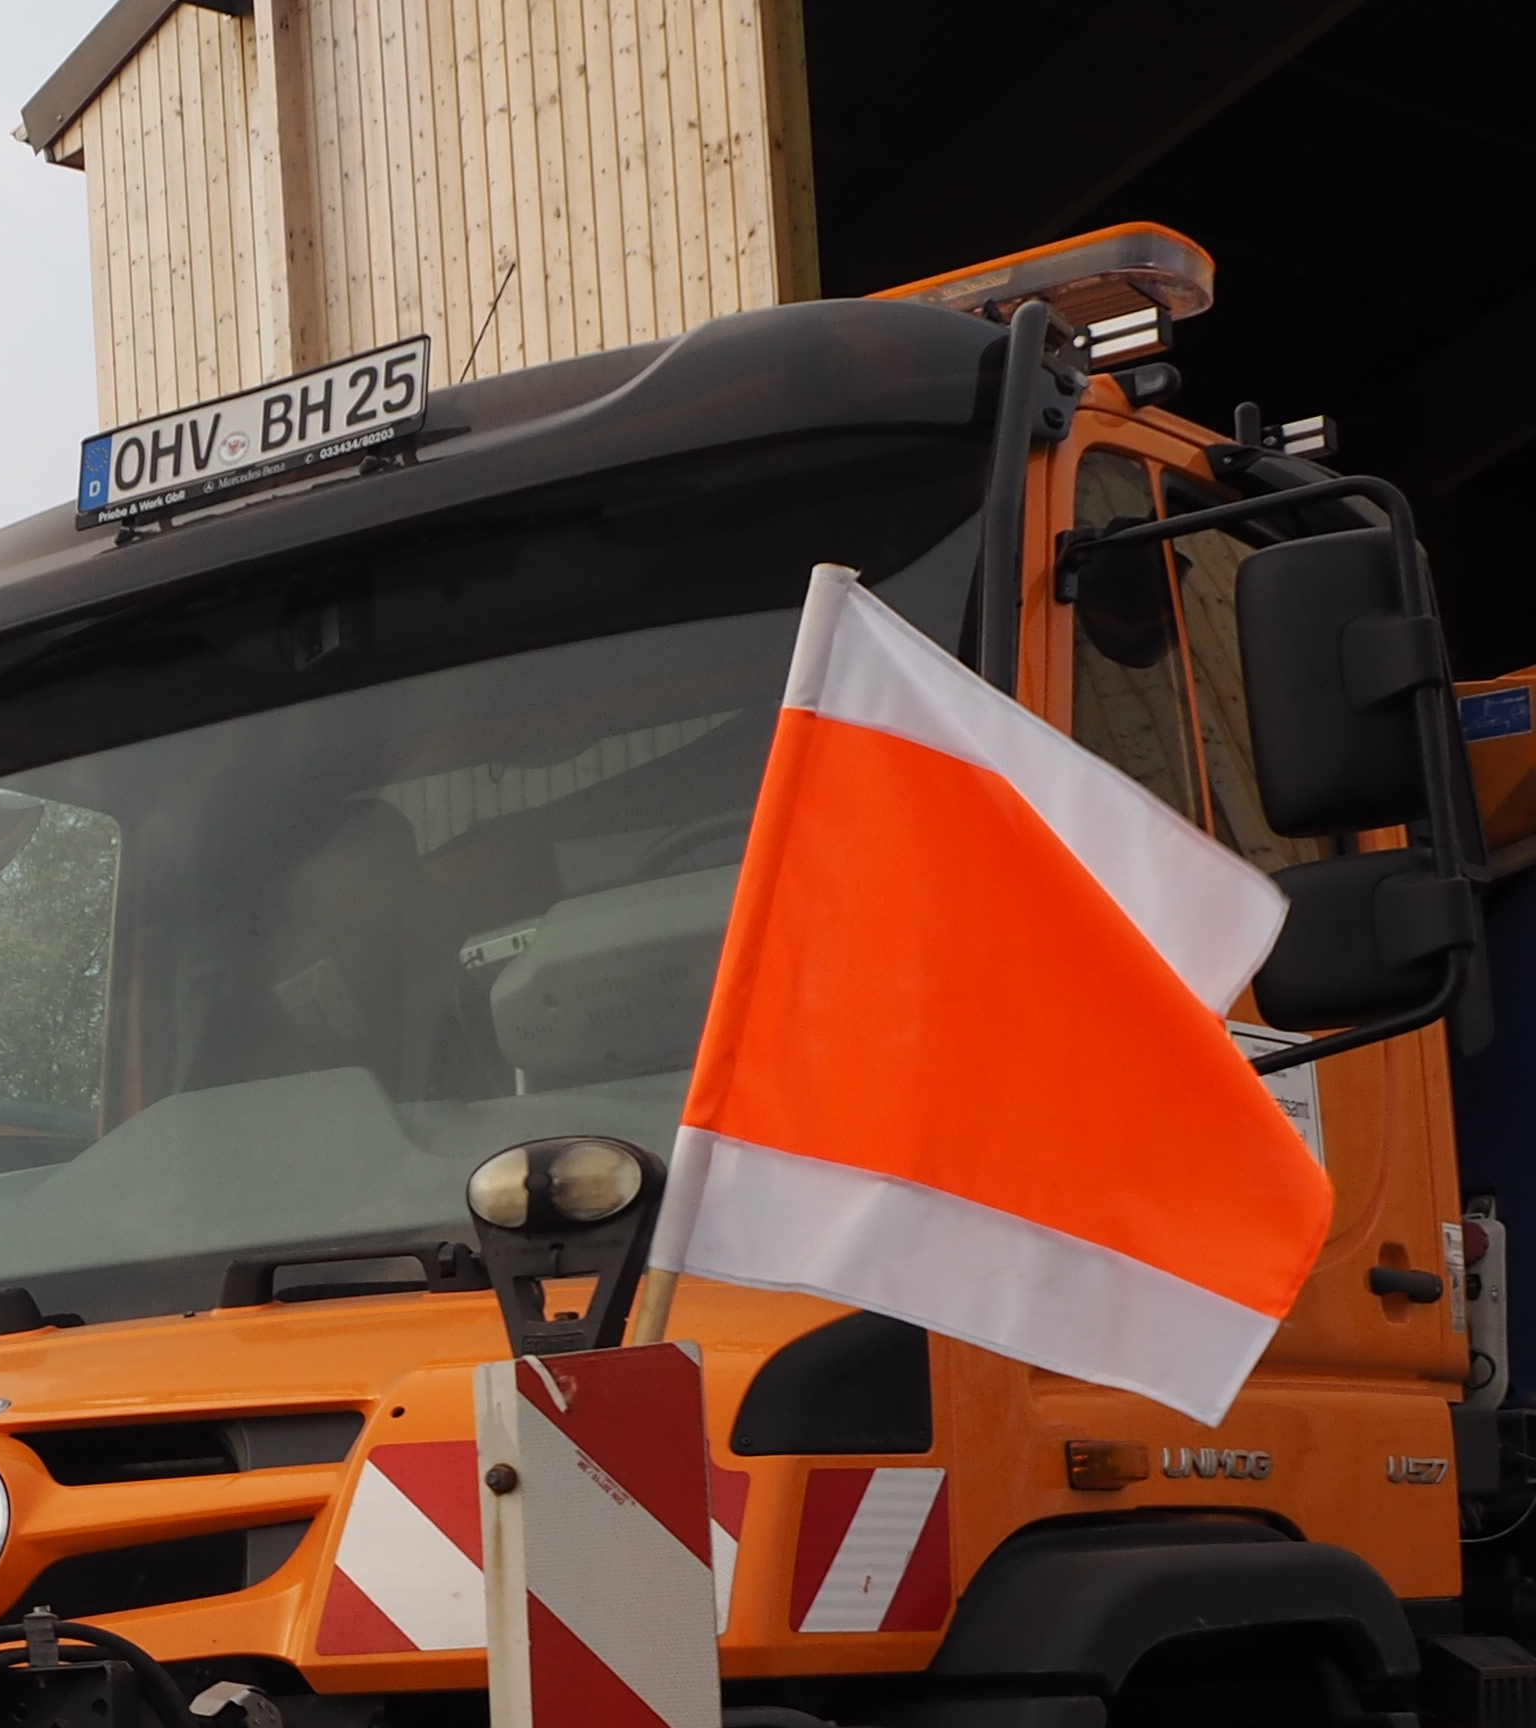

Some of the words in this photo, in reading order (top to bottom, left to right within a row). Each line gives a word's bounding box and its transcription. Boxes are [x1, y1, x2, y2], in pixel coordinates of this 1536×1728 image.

[89, 480, 101, 497] D
[114, 413, 222, 491] OHV
[261, 379, 333, 452] BH
[346, 353, 417, 427] 25
[1162, 1447, 1271, 1479] UNIMOG
[1387, 1455, 1449, 1484] U527
